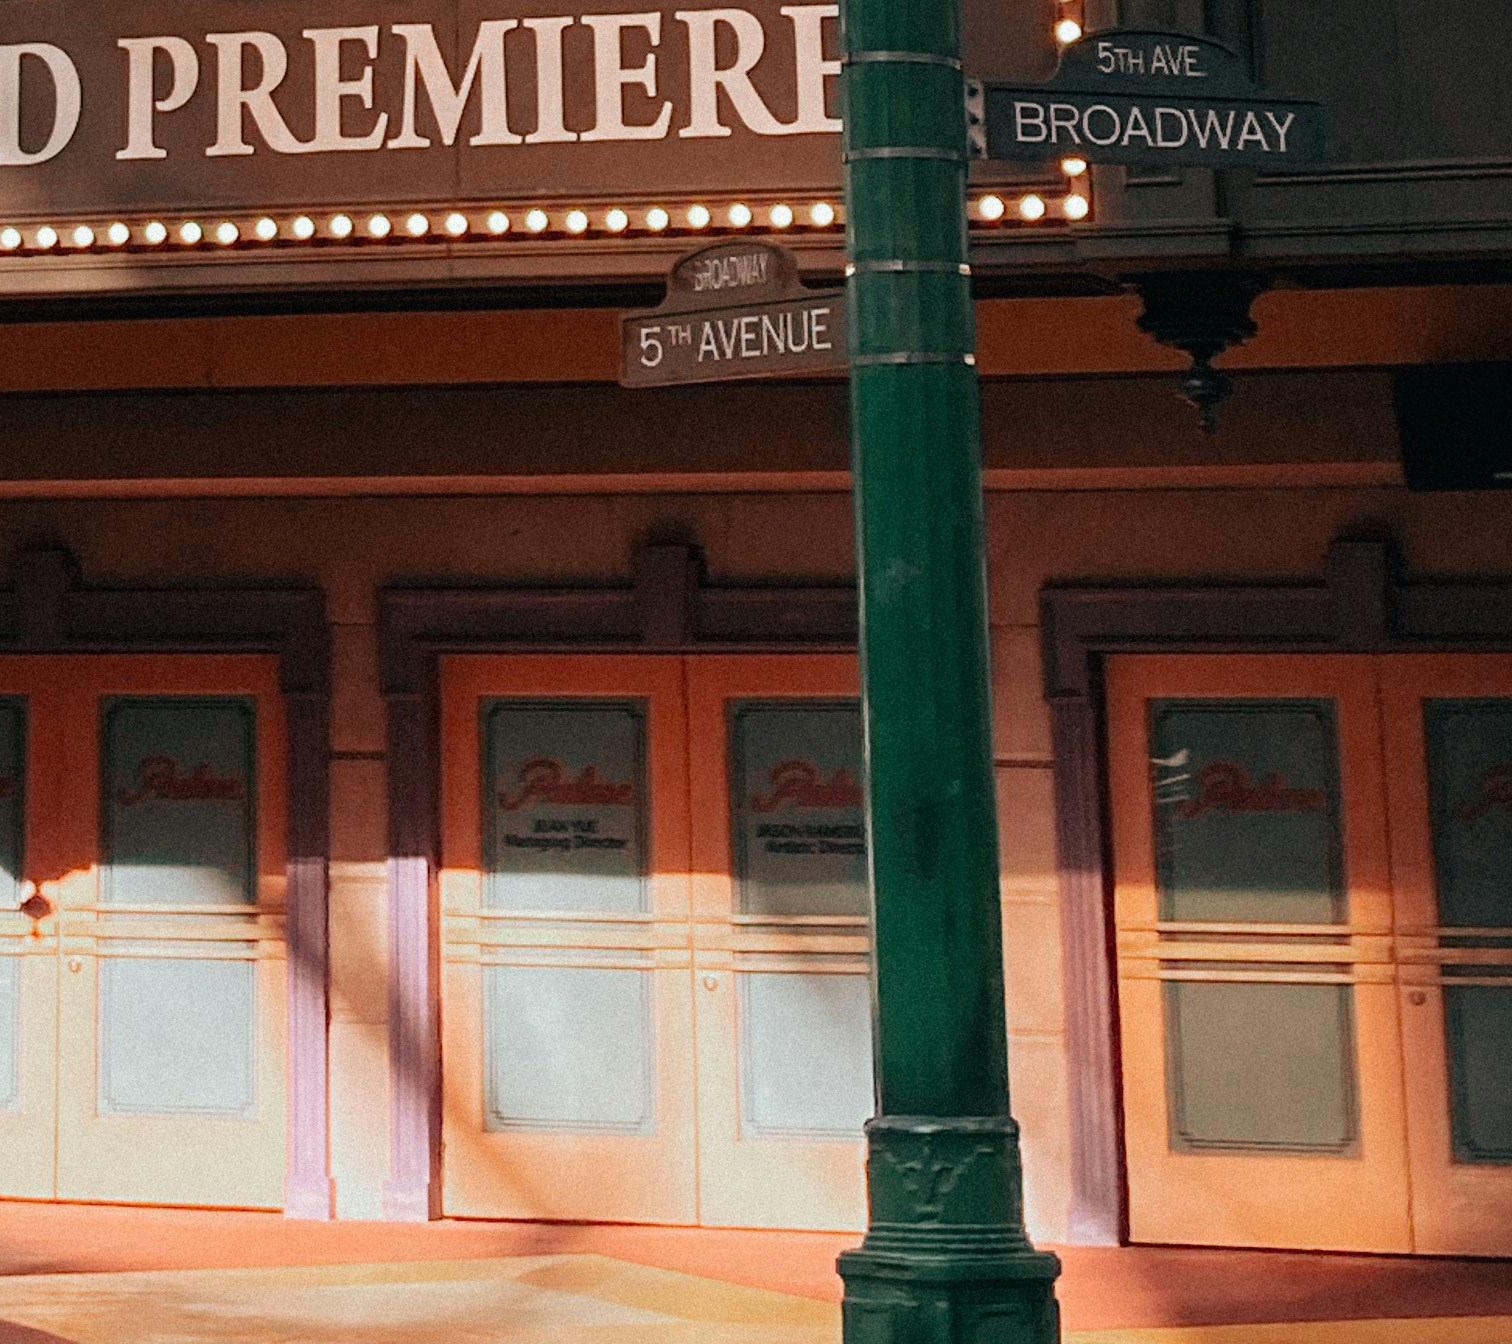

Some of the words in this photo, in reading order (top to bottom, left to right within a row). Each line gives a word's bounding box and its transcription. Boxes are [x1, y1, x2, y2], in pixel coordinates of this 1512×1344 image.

[114, 4, 844, 162] PREMIERE
[1096, 42, 1145, 75] 5TH
[1151, 44, 1208, 78] AVE
[1013, 101, 1296, 153] BROADWAY
[693, 252, 769, 292] BROADWAY
[639, 323, 692, 368] 5TH
[697, 307, 832, 363] AVENUE
